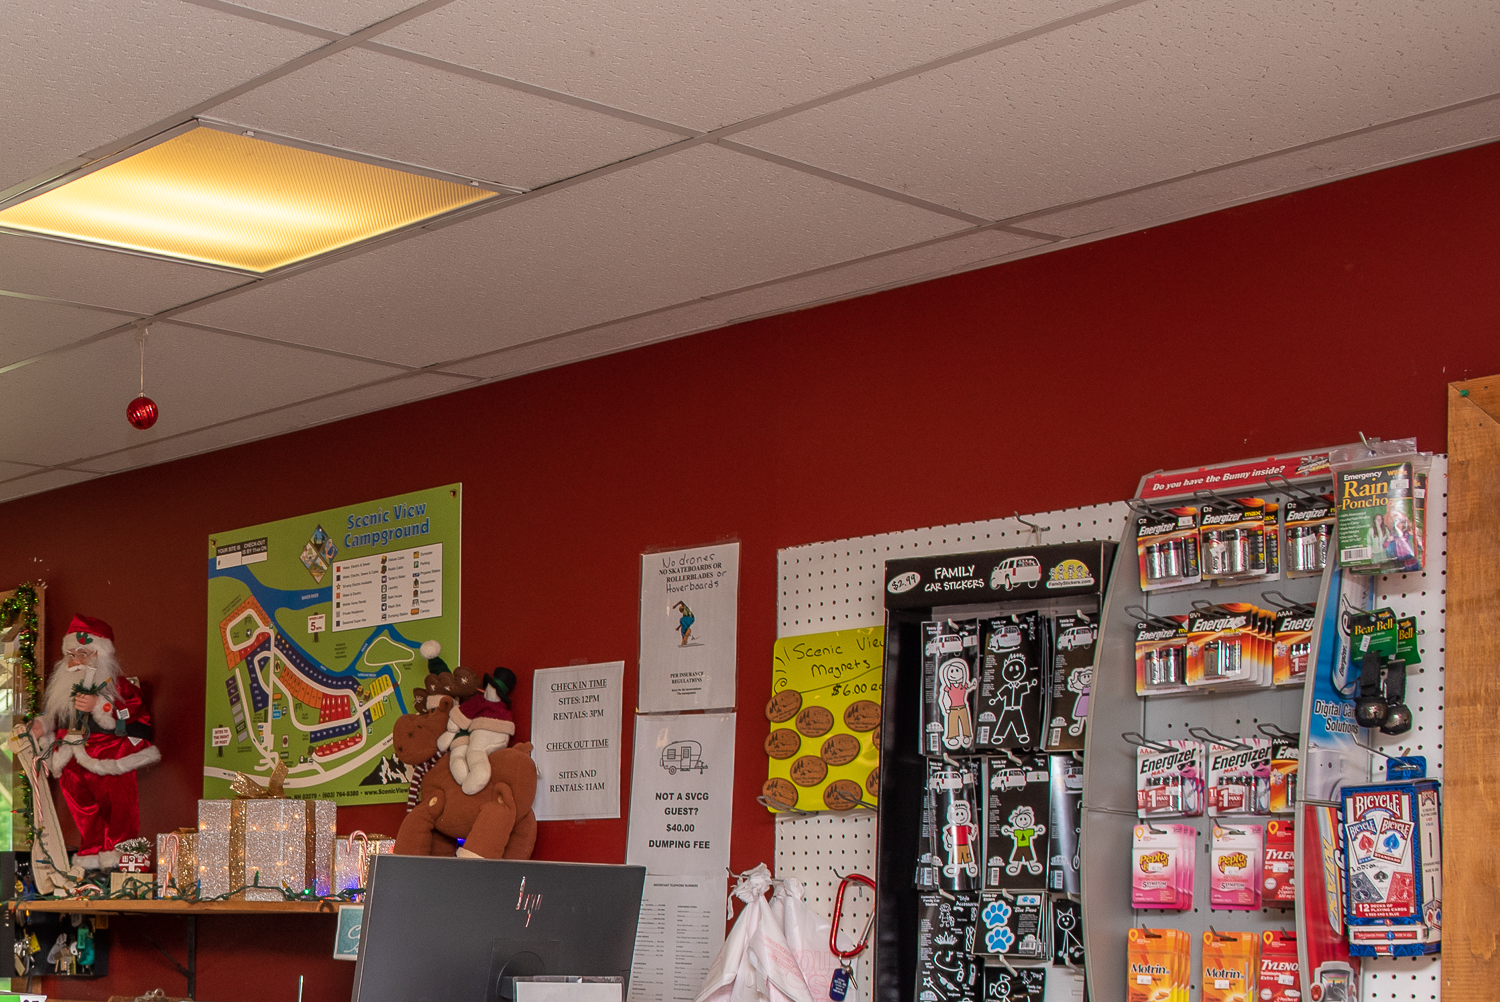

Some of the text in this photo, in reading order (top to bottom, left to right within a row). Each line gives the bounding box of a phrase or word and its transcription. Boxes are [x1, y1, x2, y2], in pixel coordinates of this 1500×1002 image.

[1153, 465, 1285, 491] Do you have the Bunny inside?
[1344, 471, 1382, 481] Emergency
[1343, 478, 1388, 498] Rain
[1342, 497, 1388, 510] Poncho
[347, 502, 427, 530] Scenic View
[344, 517, 430, 548] Campground
[662, 553, 716, 569] No drones
[659, 562, 722, 576] NO SKATEBOARDS OR
[934, 565, 975, 580] FAMILY
[666, 572, 714, 584] ROLLERBLADES
[891, 575, 918, 590] $2.99
[924, 578, 984, 592] CAR STICKERS
[666, 580, 720, 594] Hoverboards
[1354, 618, 1394, 636] Bear Bell
[793, 639, 843, 660] Scenic
[811, 659, 870, 677] Magnets
[551, 678, 608, 691] CHECK IN TIME
[831, 684, 866, 696] $6.00
[558, 694, 600, 706] SITES: 12PM
[553, 709, 604, 720] RENTALS: 3PM
[546, 738, 609, 750] CHECK OUT TIME
[1140, 748, 1196, 774] Energizer
[1212, 747, 1271, 772] Energizer
[558, 769, 597, 780] SITES AND
[550, 782, 605, 793] RENTALS: 11AM
[655, 792, 709, 800] NOT A SVCG
[664, 808, 698, 816] GUEST?
[1355, 794, 1400, 818] BICYCLE
[666, 824, 694, 832] $40.00
[649, 840, 710, 849] DUMPING FEE
[1130, 963, 1167, 974] Motrin
